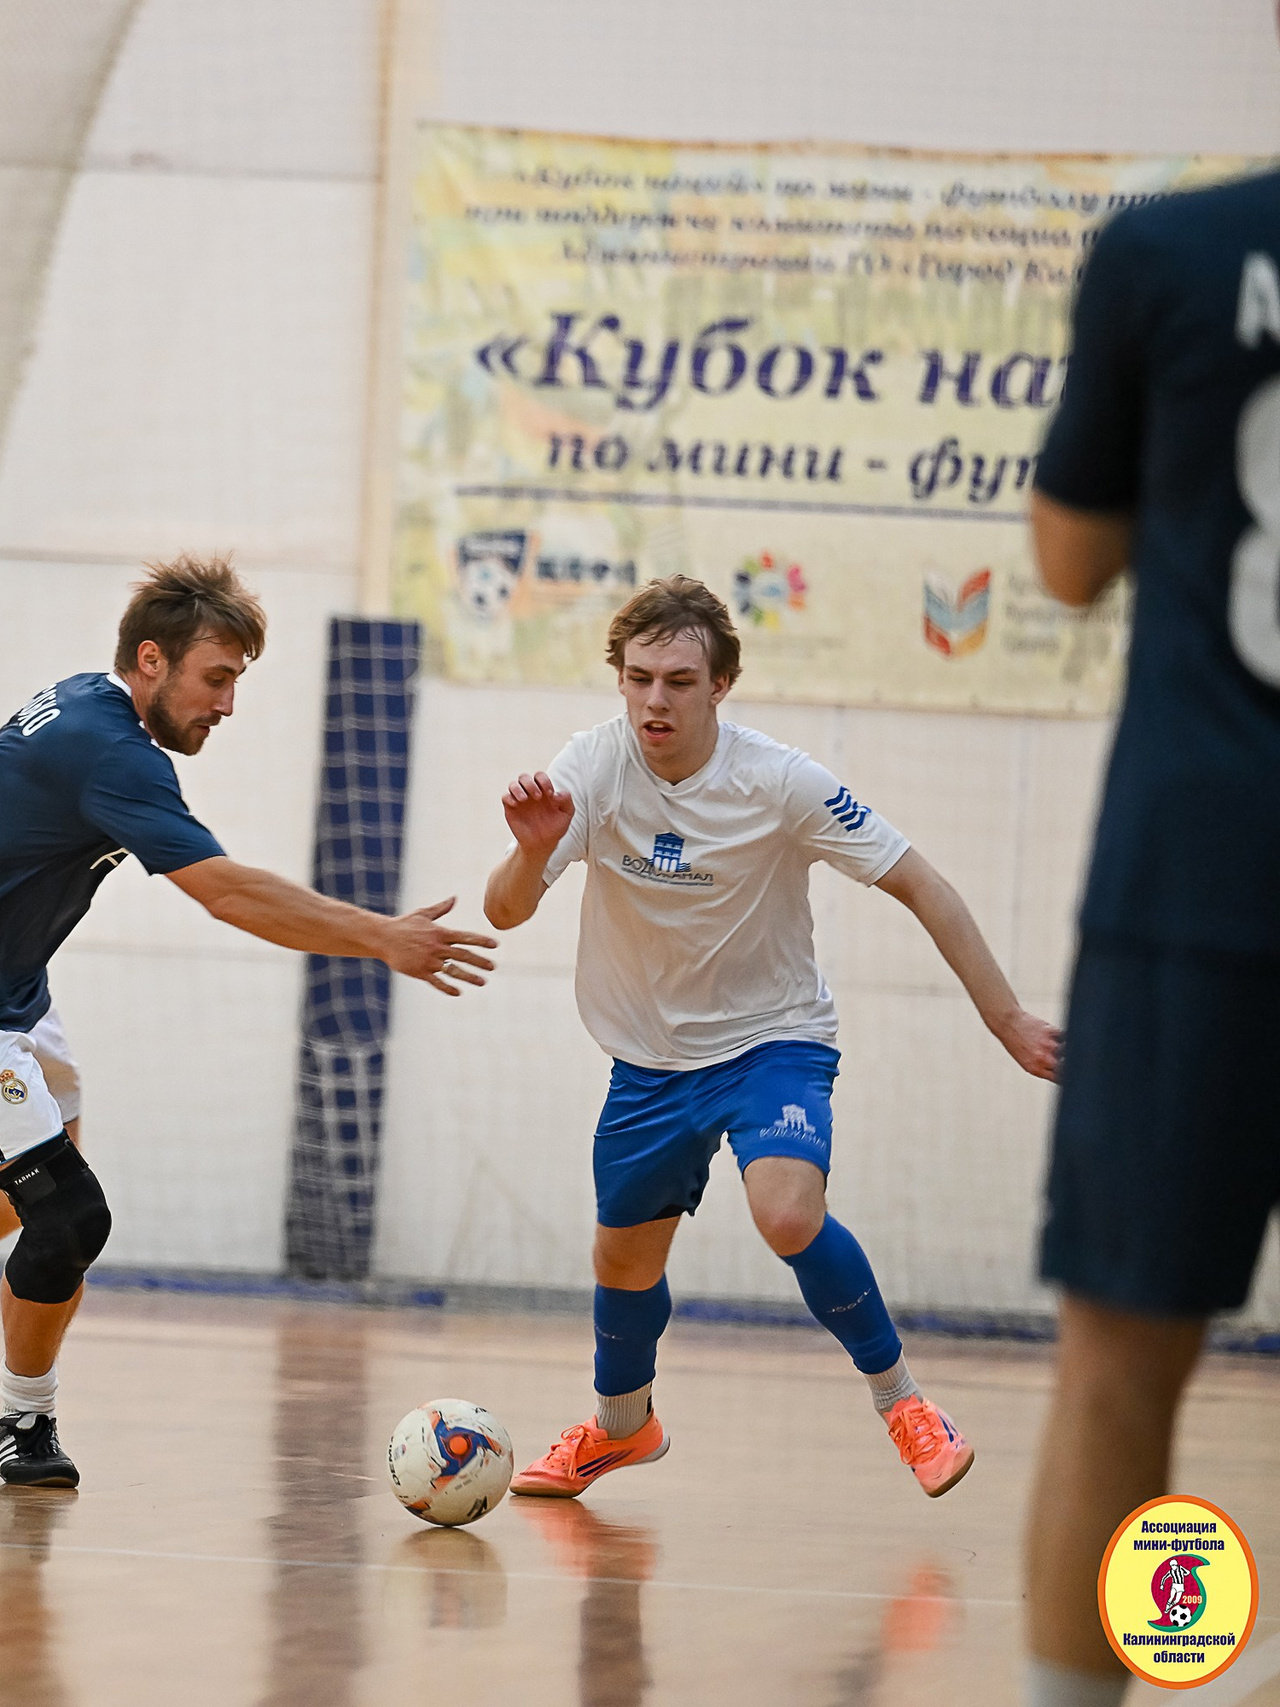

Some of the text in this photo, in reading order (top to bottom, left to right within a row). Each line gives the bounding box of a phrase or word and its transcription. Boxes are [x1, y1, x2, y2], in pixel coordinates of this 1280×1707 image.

[475, 312, 1069, 412] «Кубок на
[547, 431, 629, 471] по
[645, 437, 843, 482] мини
[13, 1167, 40, 1186] TARMAK
